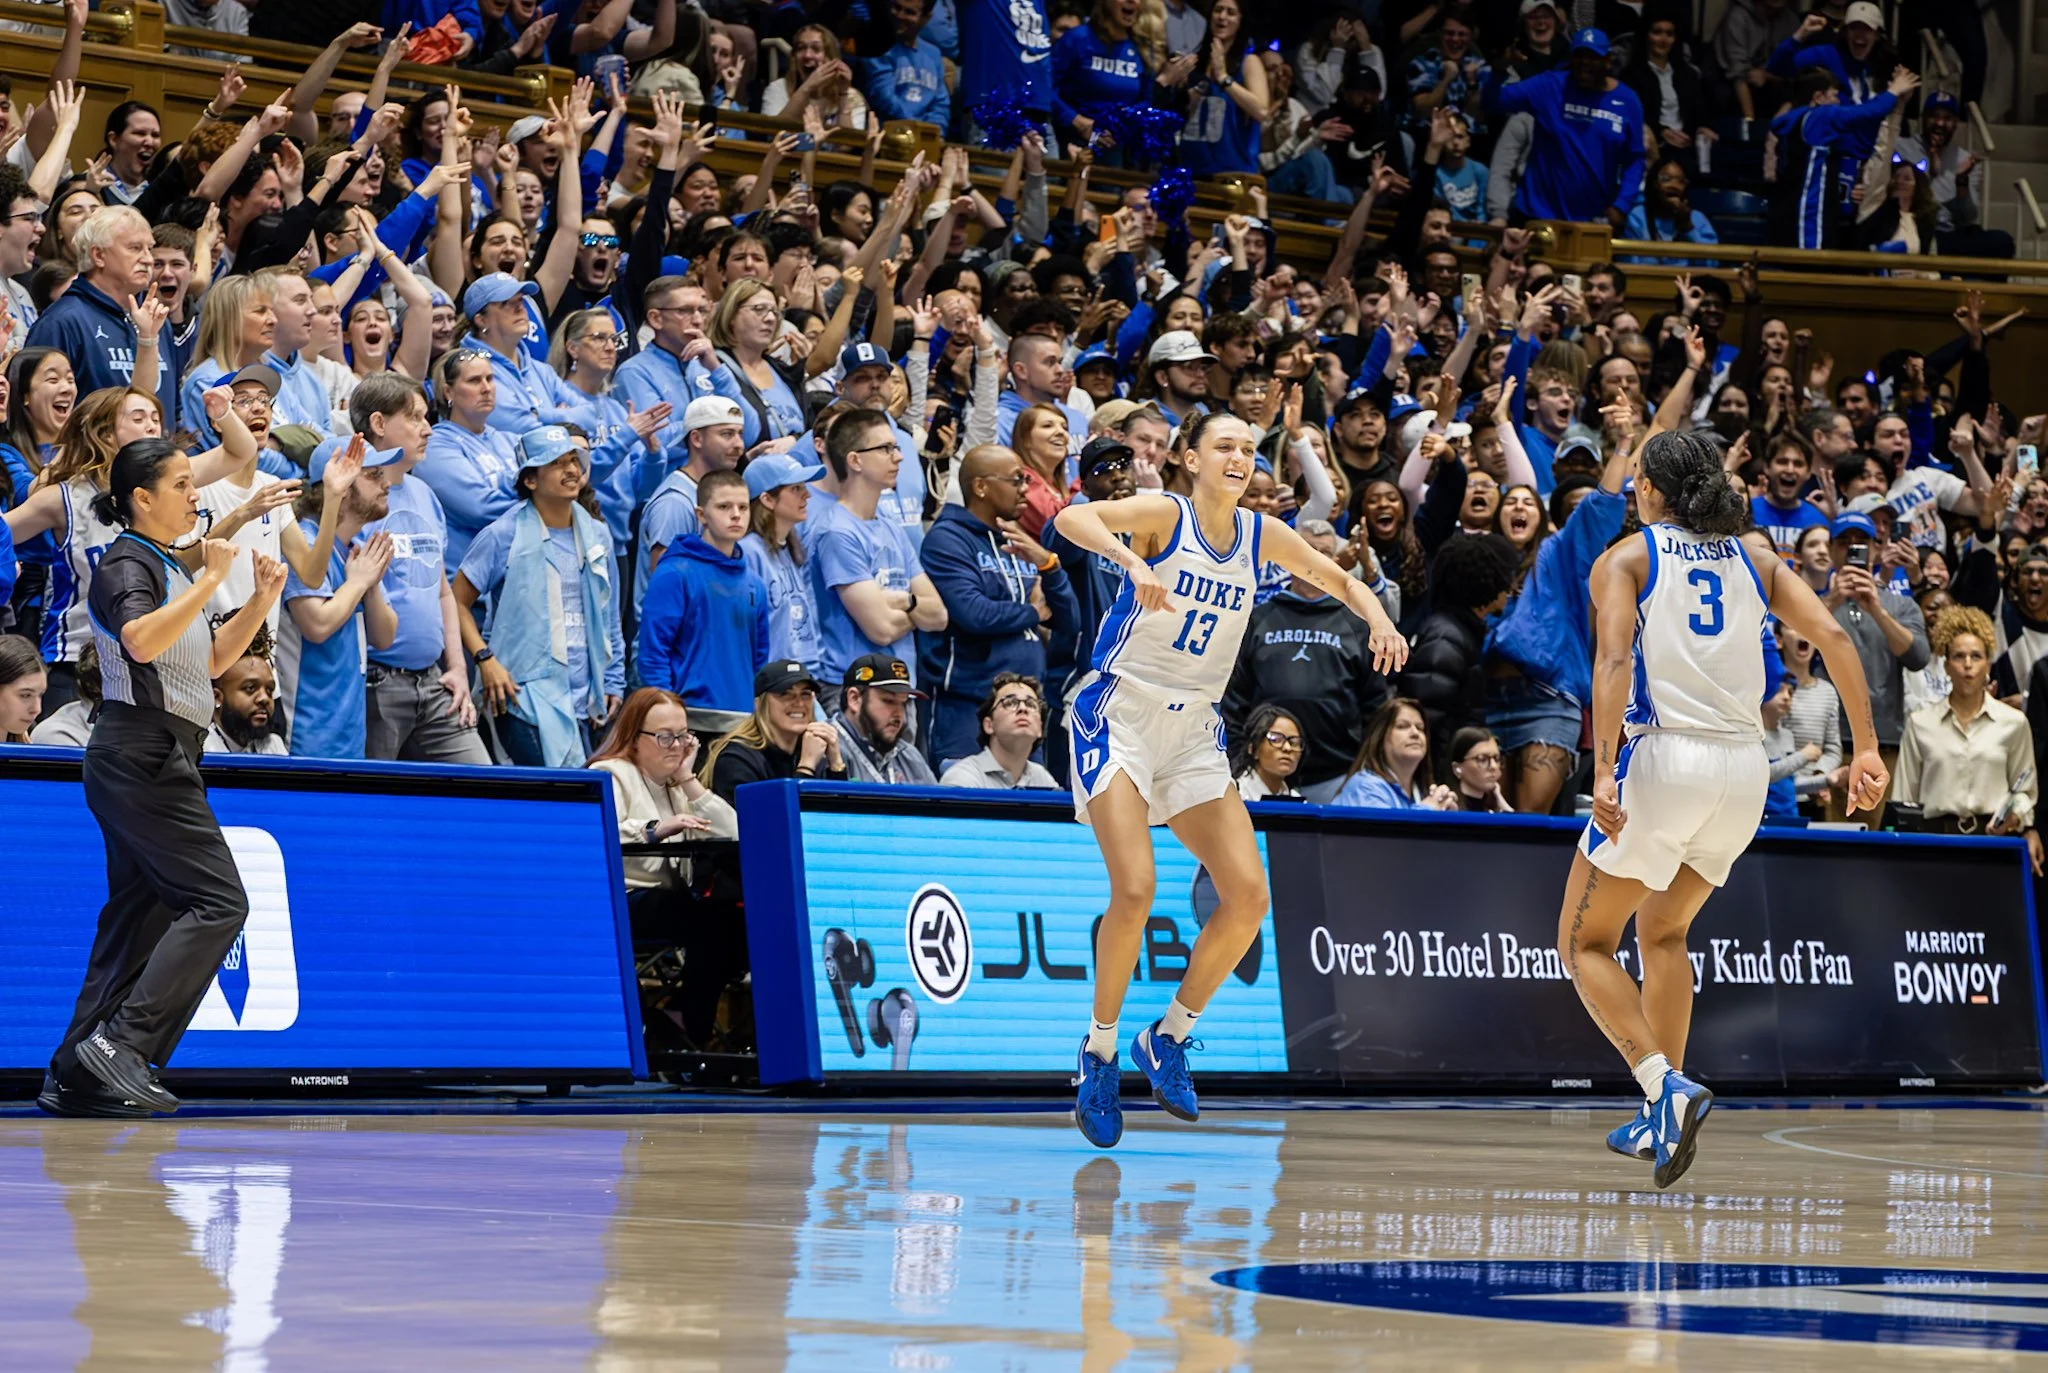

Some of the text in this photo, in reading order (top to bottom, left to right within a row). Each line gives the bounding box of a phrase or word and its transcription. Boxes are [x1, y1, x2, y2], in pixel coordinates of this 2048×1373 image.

[1091, 55, 1139, 78] DUKE
[1889, 481, 1935, 515] UKE
[1662, 537, 1738, 561] JACKSON
[1173, 569, 1246, 611] DUKE
[1687, 568, 1724, 636] 3
[1172, 609, 1218, 656] 13
[1264, 629, 1342, 648] CAROLINA
[1082, 748, 1100, 776] D
[1310, 926, 1376, 975] Over
[1383, 930, 1414, 977] 30
[1419, 931, 1496, 979] Hotel
[1905, 930, 1985, 954] MARRIOTT
[1710, 938, 1776, 985] Kind
[1779, 940, 1805, 985] of
[1806, 940, 1854, 986] Fan
[91, 1034, 116, 1059] HOKA
[291, 1075, 349, 1086] DAKTRONICS
